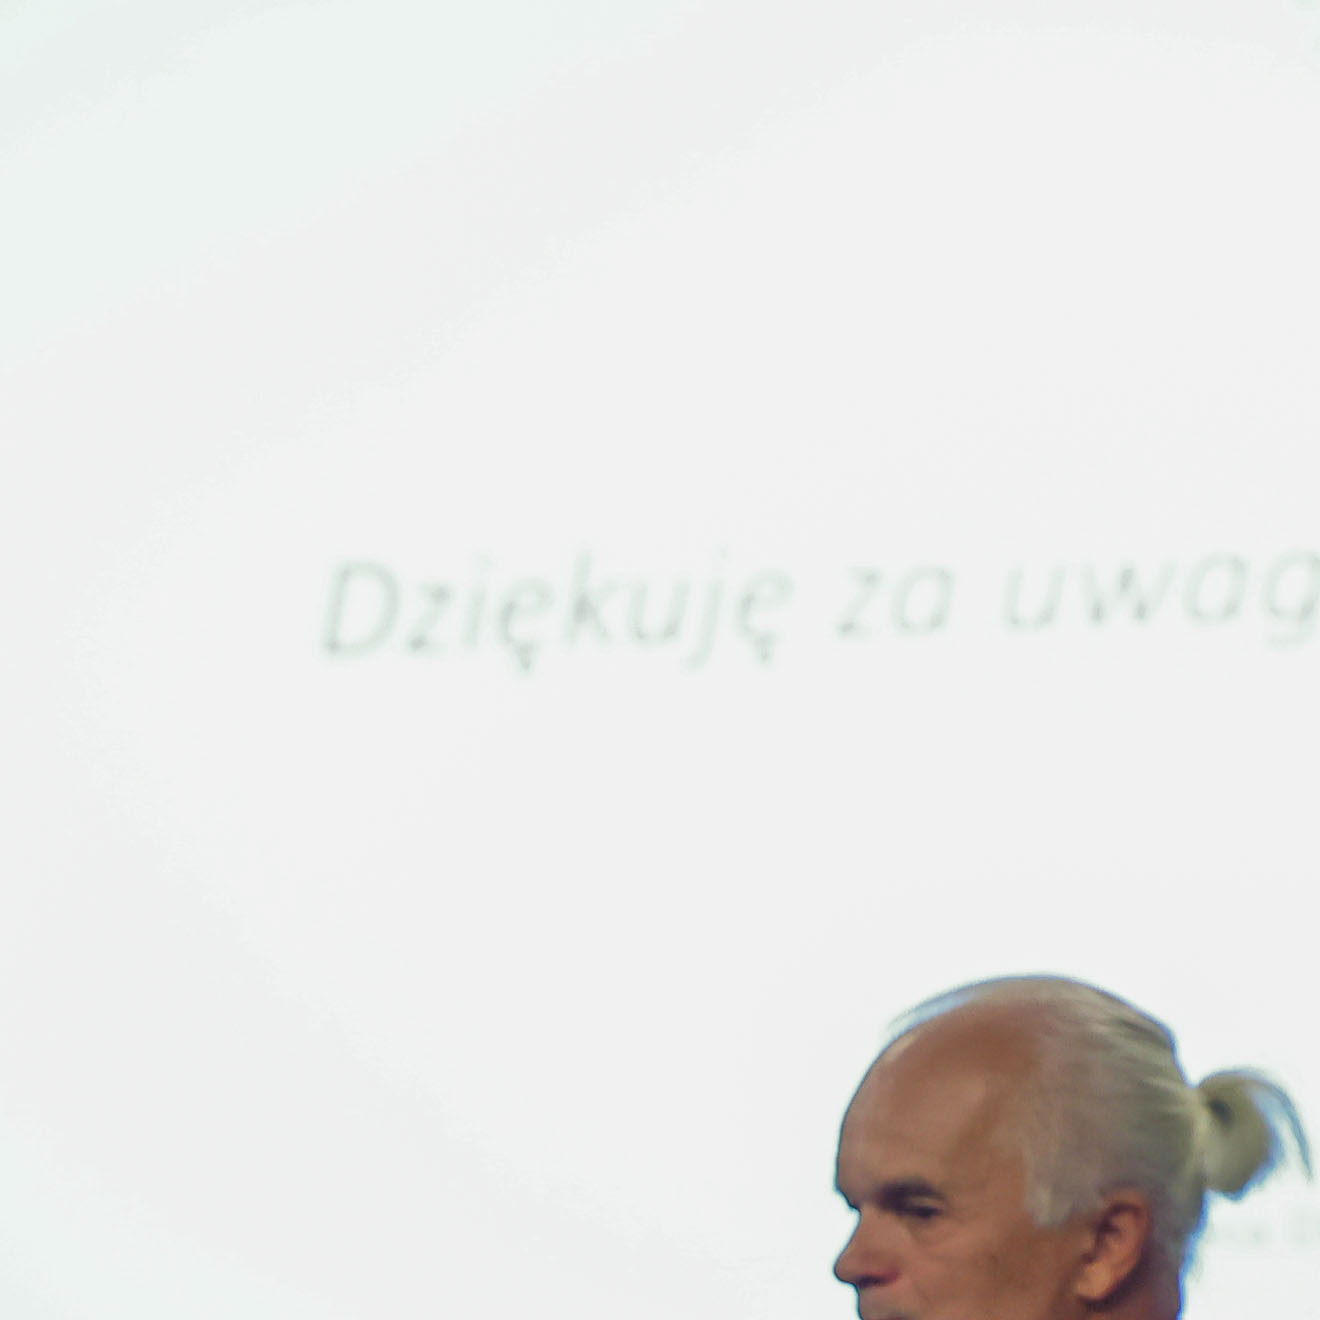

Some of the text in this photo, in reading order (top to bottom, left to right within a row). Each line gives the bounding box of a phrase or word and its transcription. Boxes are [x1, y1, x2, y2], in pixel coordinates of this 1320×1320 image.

[322, 548, 1320, 674] Dziękuję za uwag
